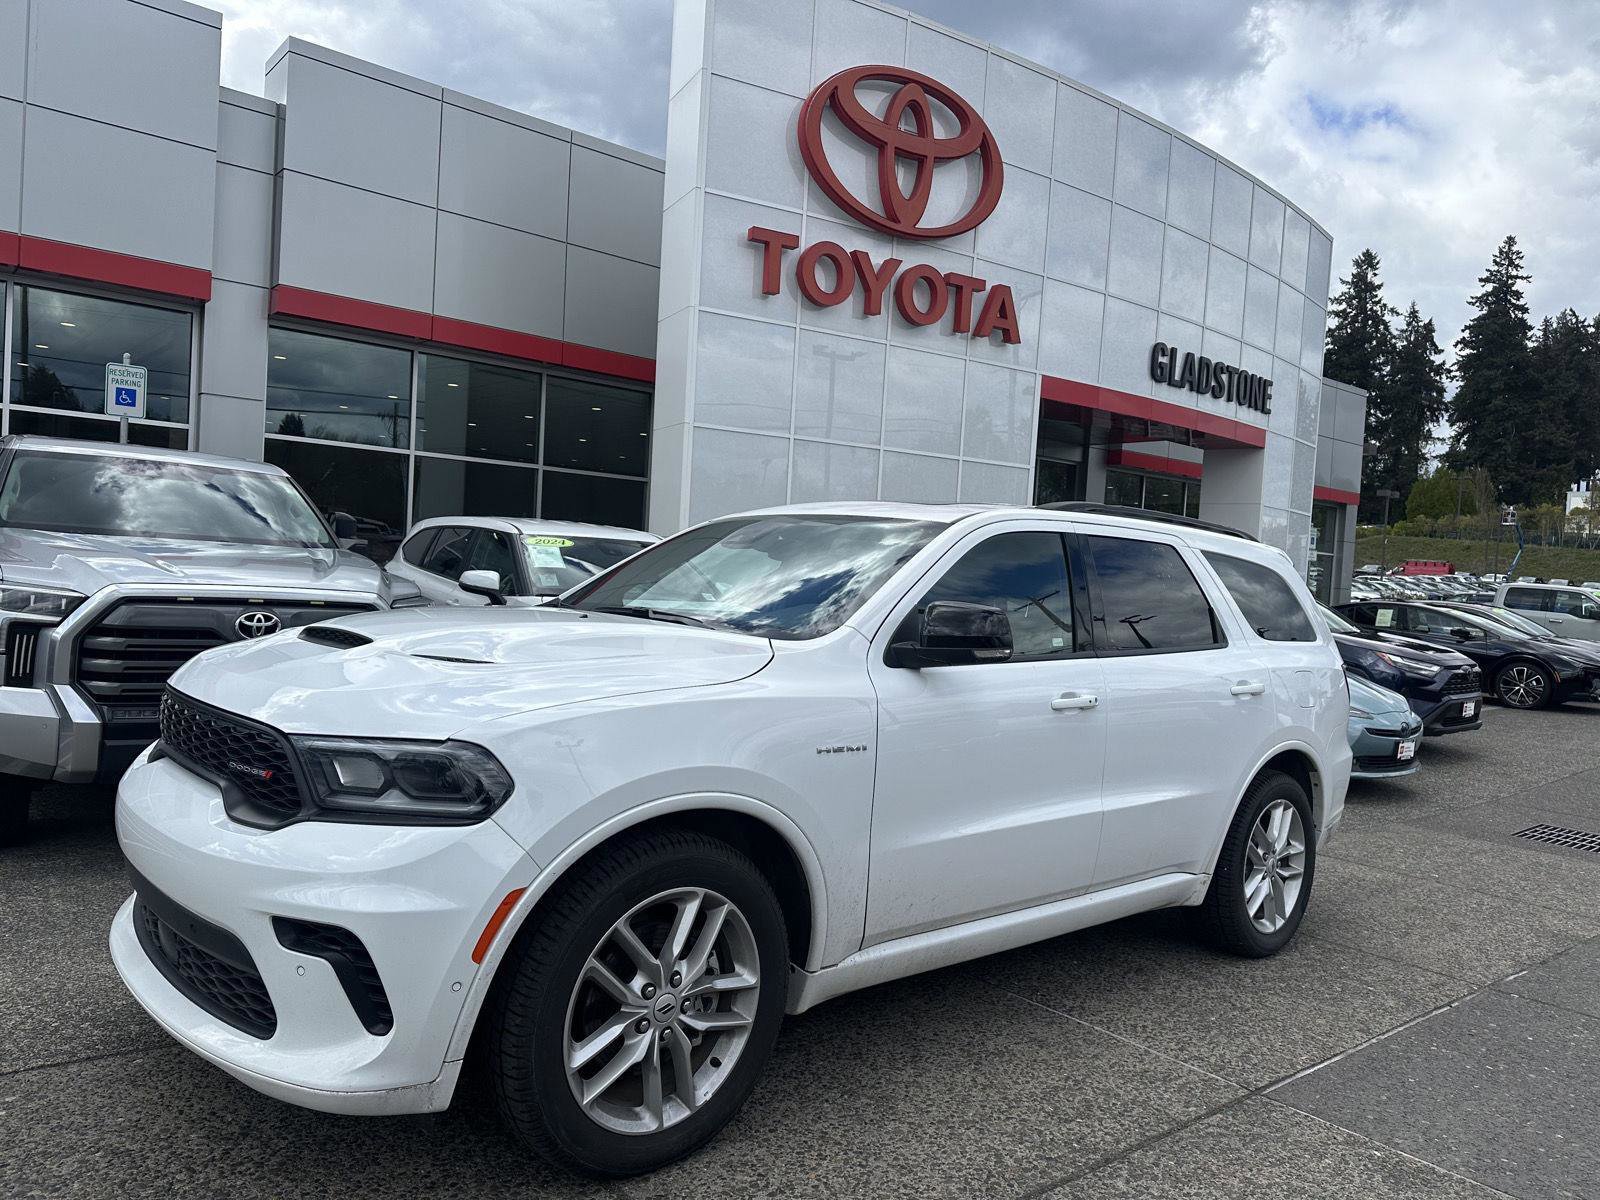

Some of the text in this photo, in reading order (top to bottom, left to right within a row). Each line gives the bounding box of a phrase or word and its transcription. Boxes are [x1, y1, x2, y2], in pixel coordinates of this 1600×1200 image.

[748, 226, 1021, 345] TOYOTA
[109, 368, 144, 380] RESERVED
[1151, 342, 1273, 415] GLADSTONE
[111, 378, 142, 388] PARKING
[816, 744, 868, 754] HEMI
[228, 761, 267, 777] DODGE
